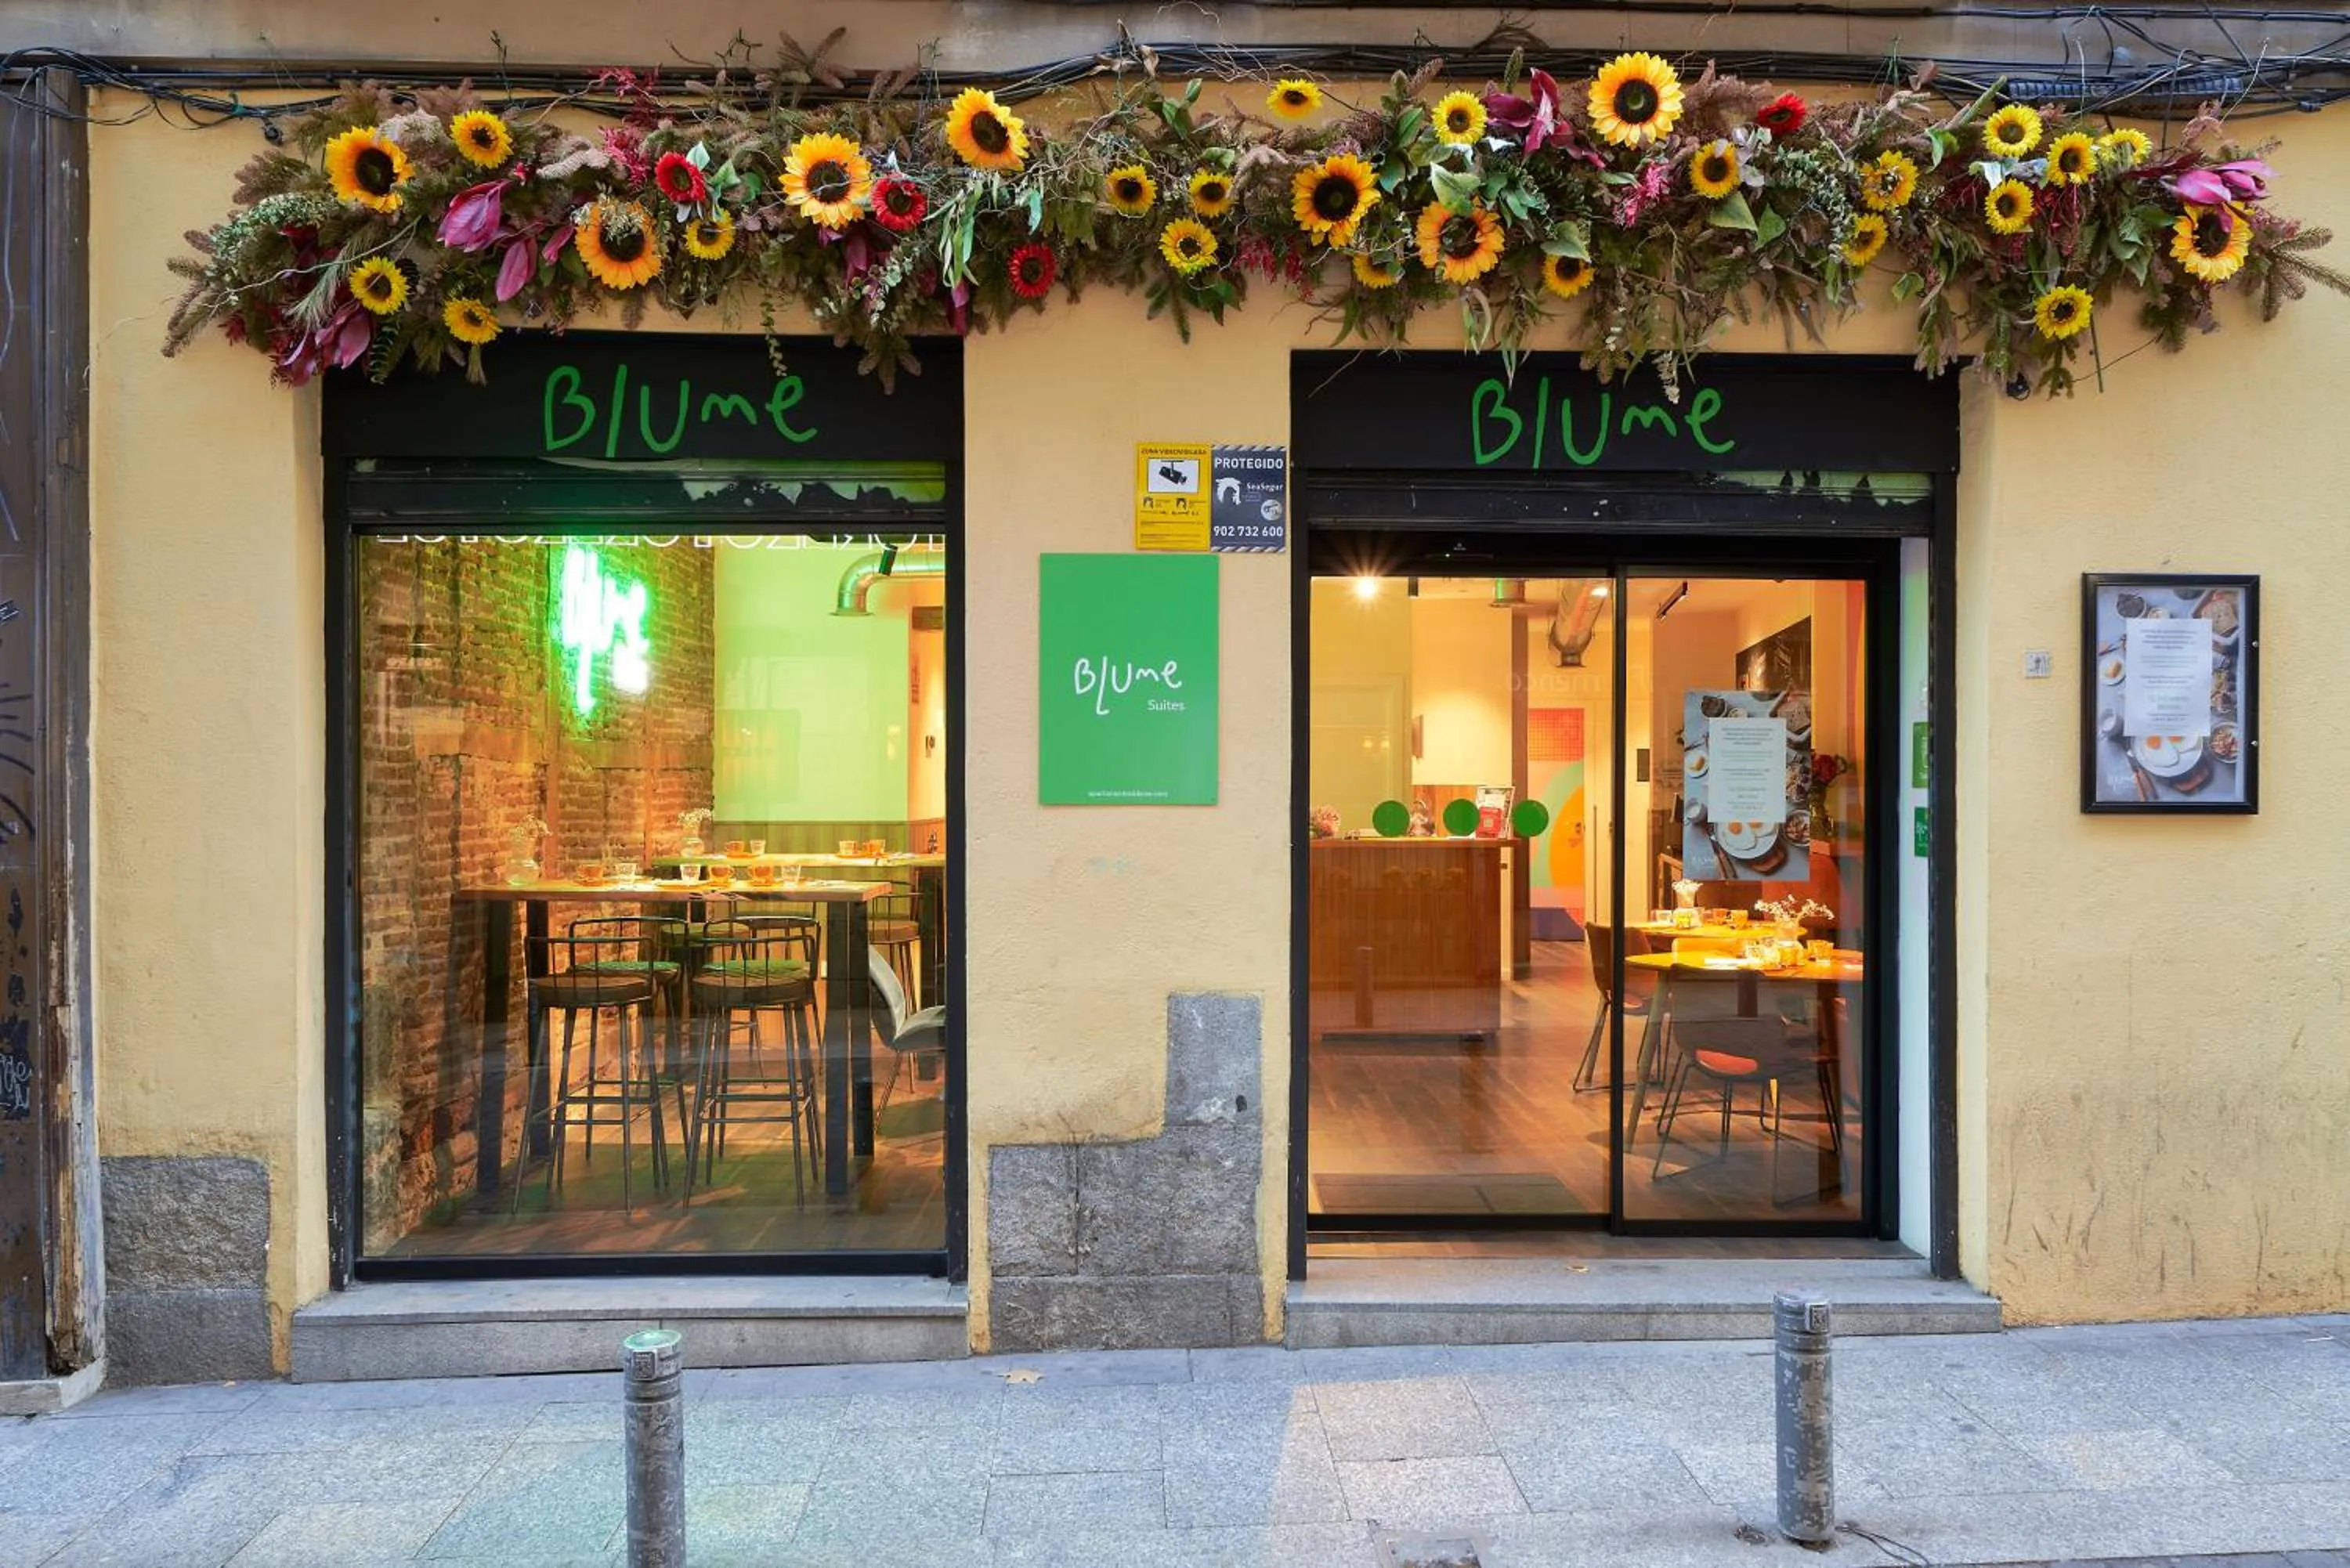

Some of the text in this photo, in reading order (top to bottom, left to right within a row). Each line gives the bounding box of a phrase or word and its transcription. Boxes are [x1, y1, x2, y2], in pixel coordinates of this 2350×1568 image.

[1215, 457, 1284, 469] PROTEGIDO
[1214, 526, 1235, 537] 902
[1237, 526, 1259, 537] 732
[1262, 526, 1284, 537] 600
[1147, 699, 1185, 711] Suites
